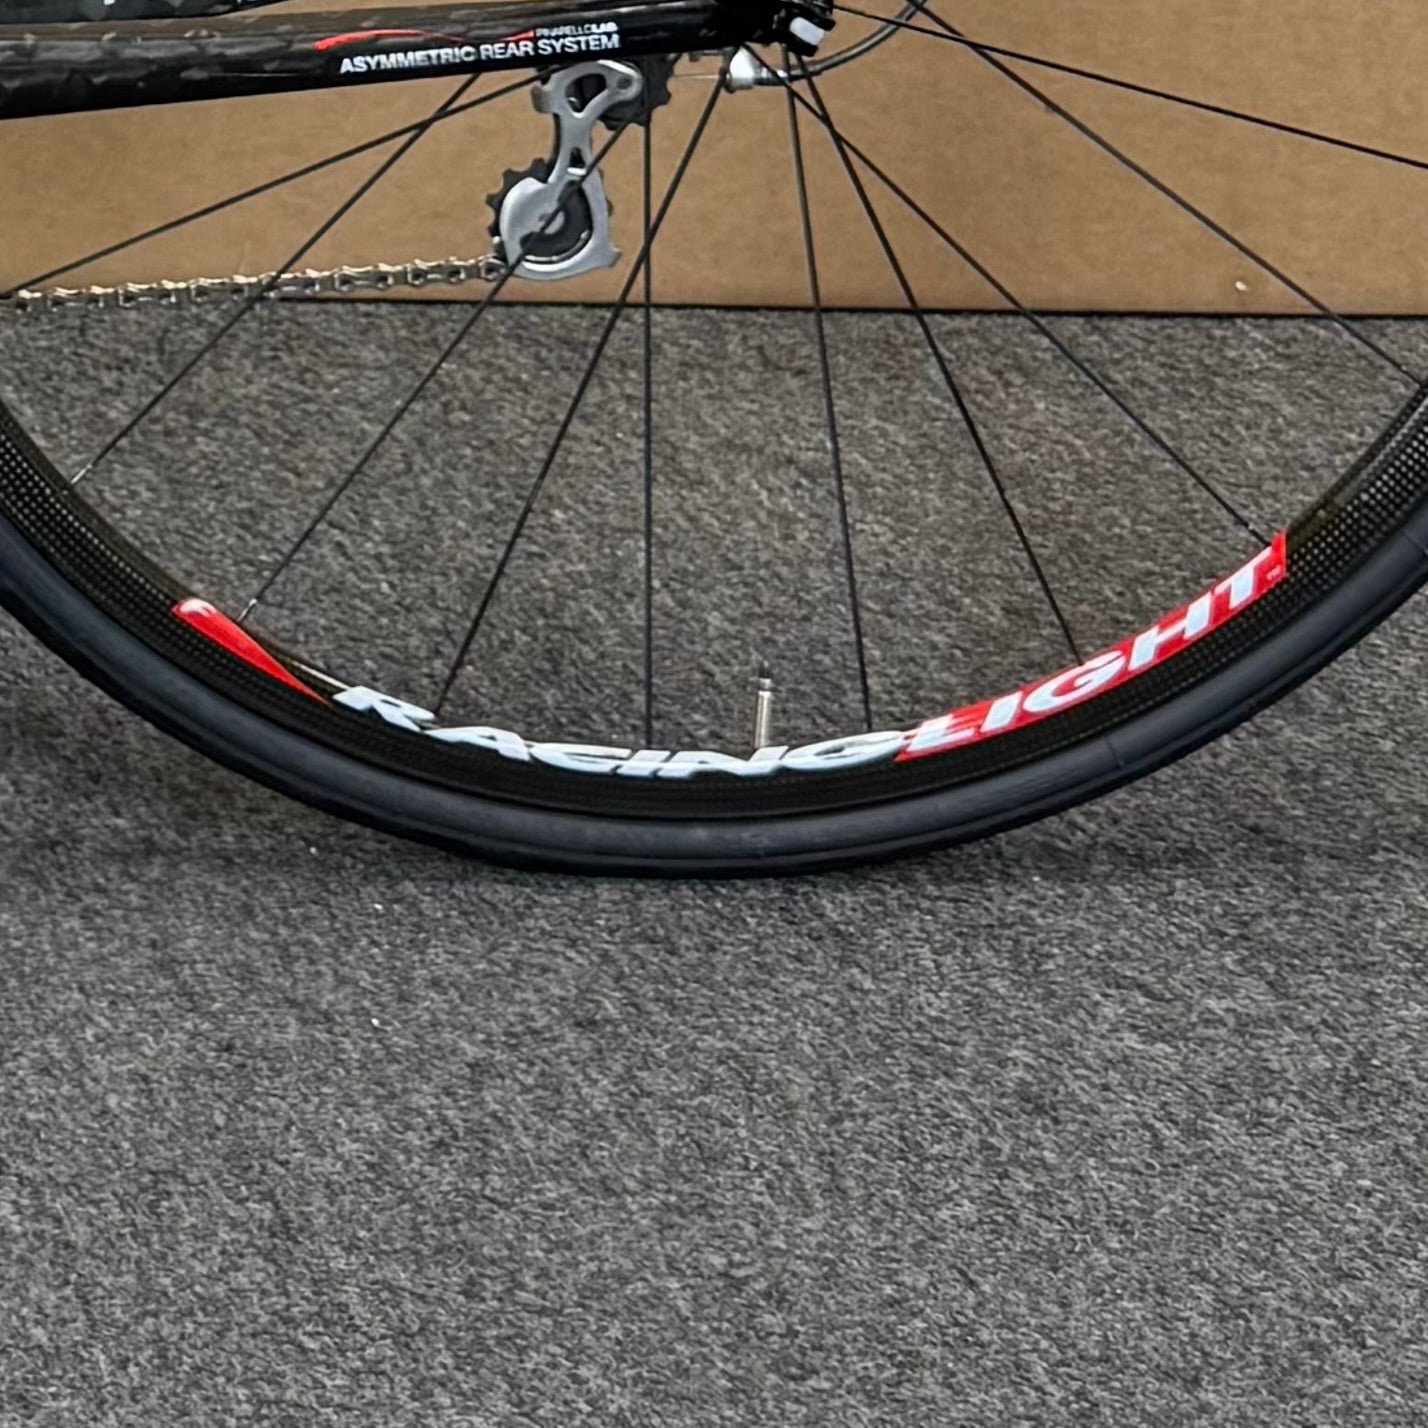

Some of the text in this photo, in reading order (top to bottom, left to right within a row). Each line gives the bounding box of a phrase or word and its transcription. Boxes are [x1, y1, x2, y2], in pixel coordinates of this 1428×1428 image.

[339, 33, 621, 75] ASYMMETRIC REAR SYSTEM
